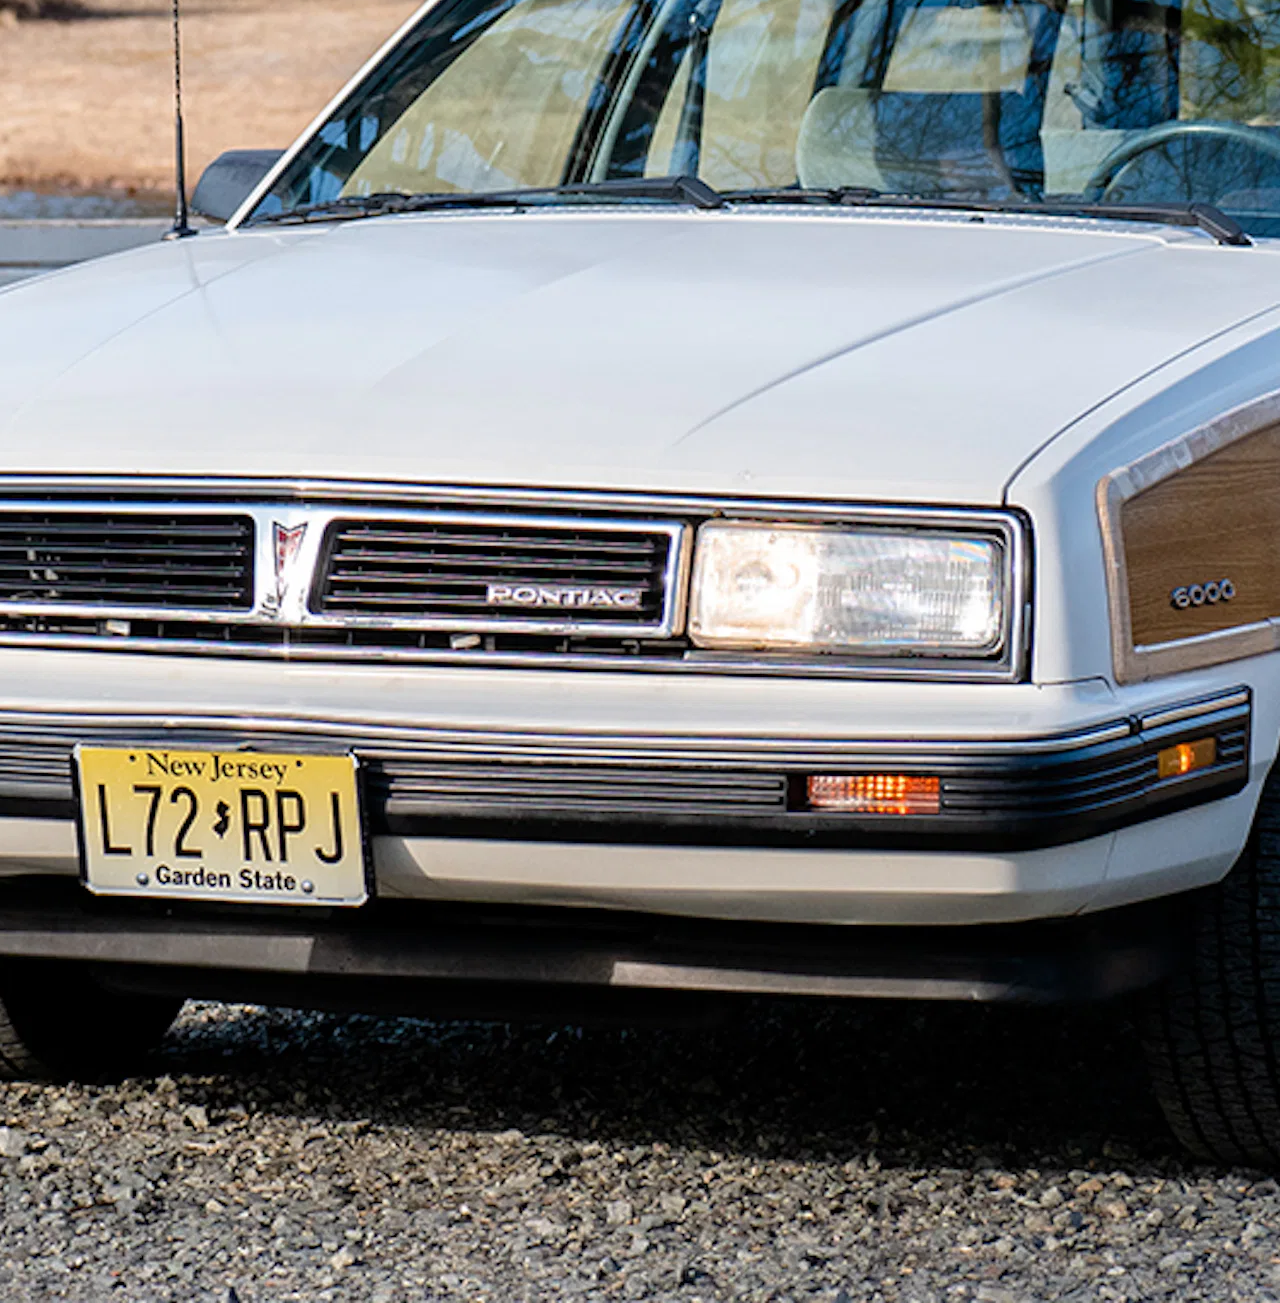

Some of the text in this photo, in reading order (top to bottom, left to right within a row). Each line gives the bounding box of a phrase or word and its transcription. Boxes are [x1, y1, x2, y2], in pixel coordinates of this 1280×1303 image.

[486, 584, 642, 607] PONTIAC
[1171, 578, 1236, 608] 6000
[146, 753, 288, 785] New Jersey
[155, 865, 297, 891] Garden State
